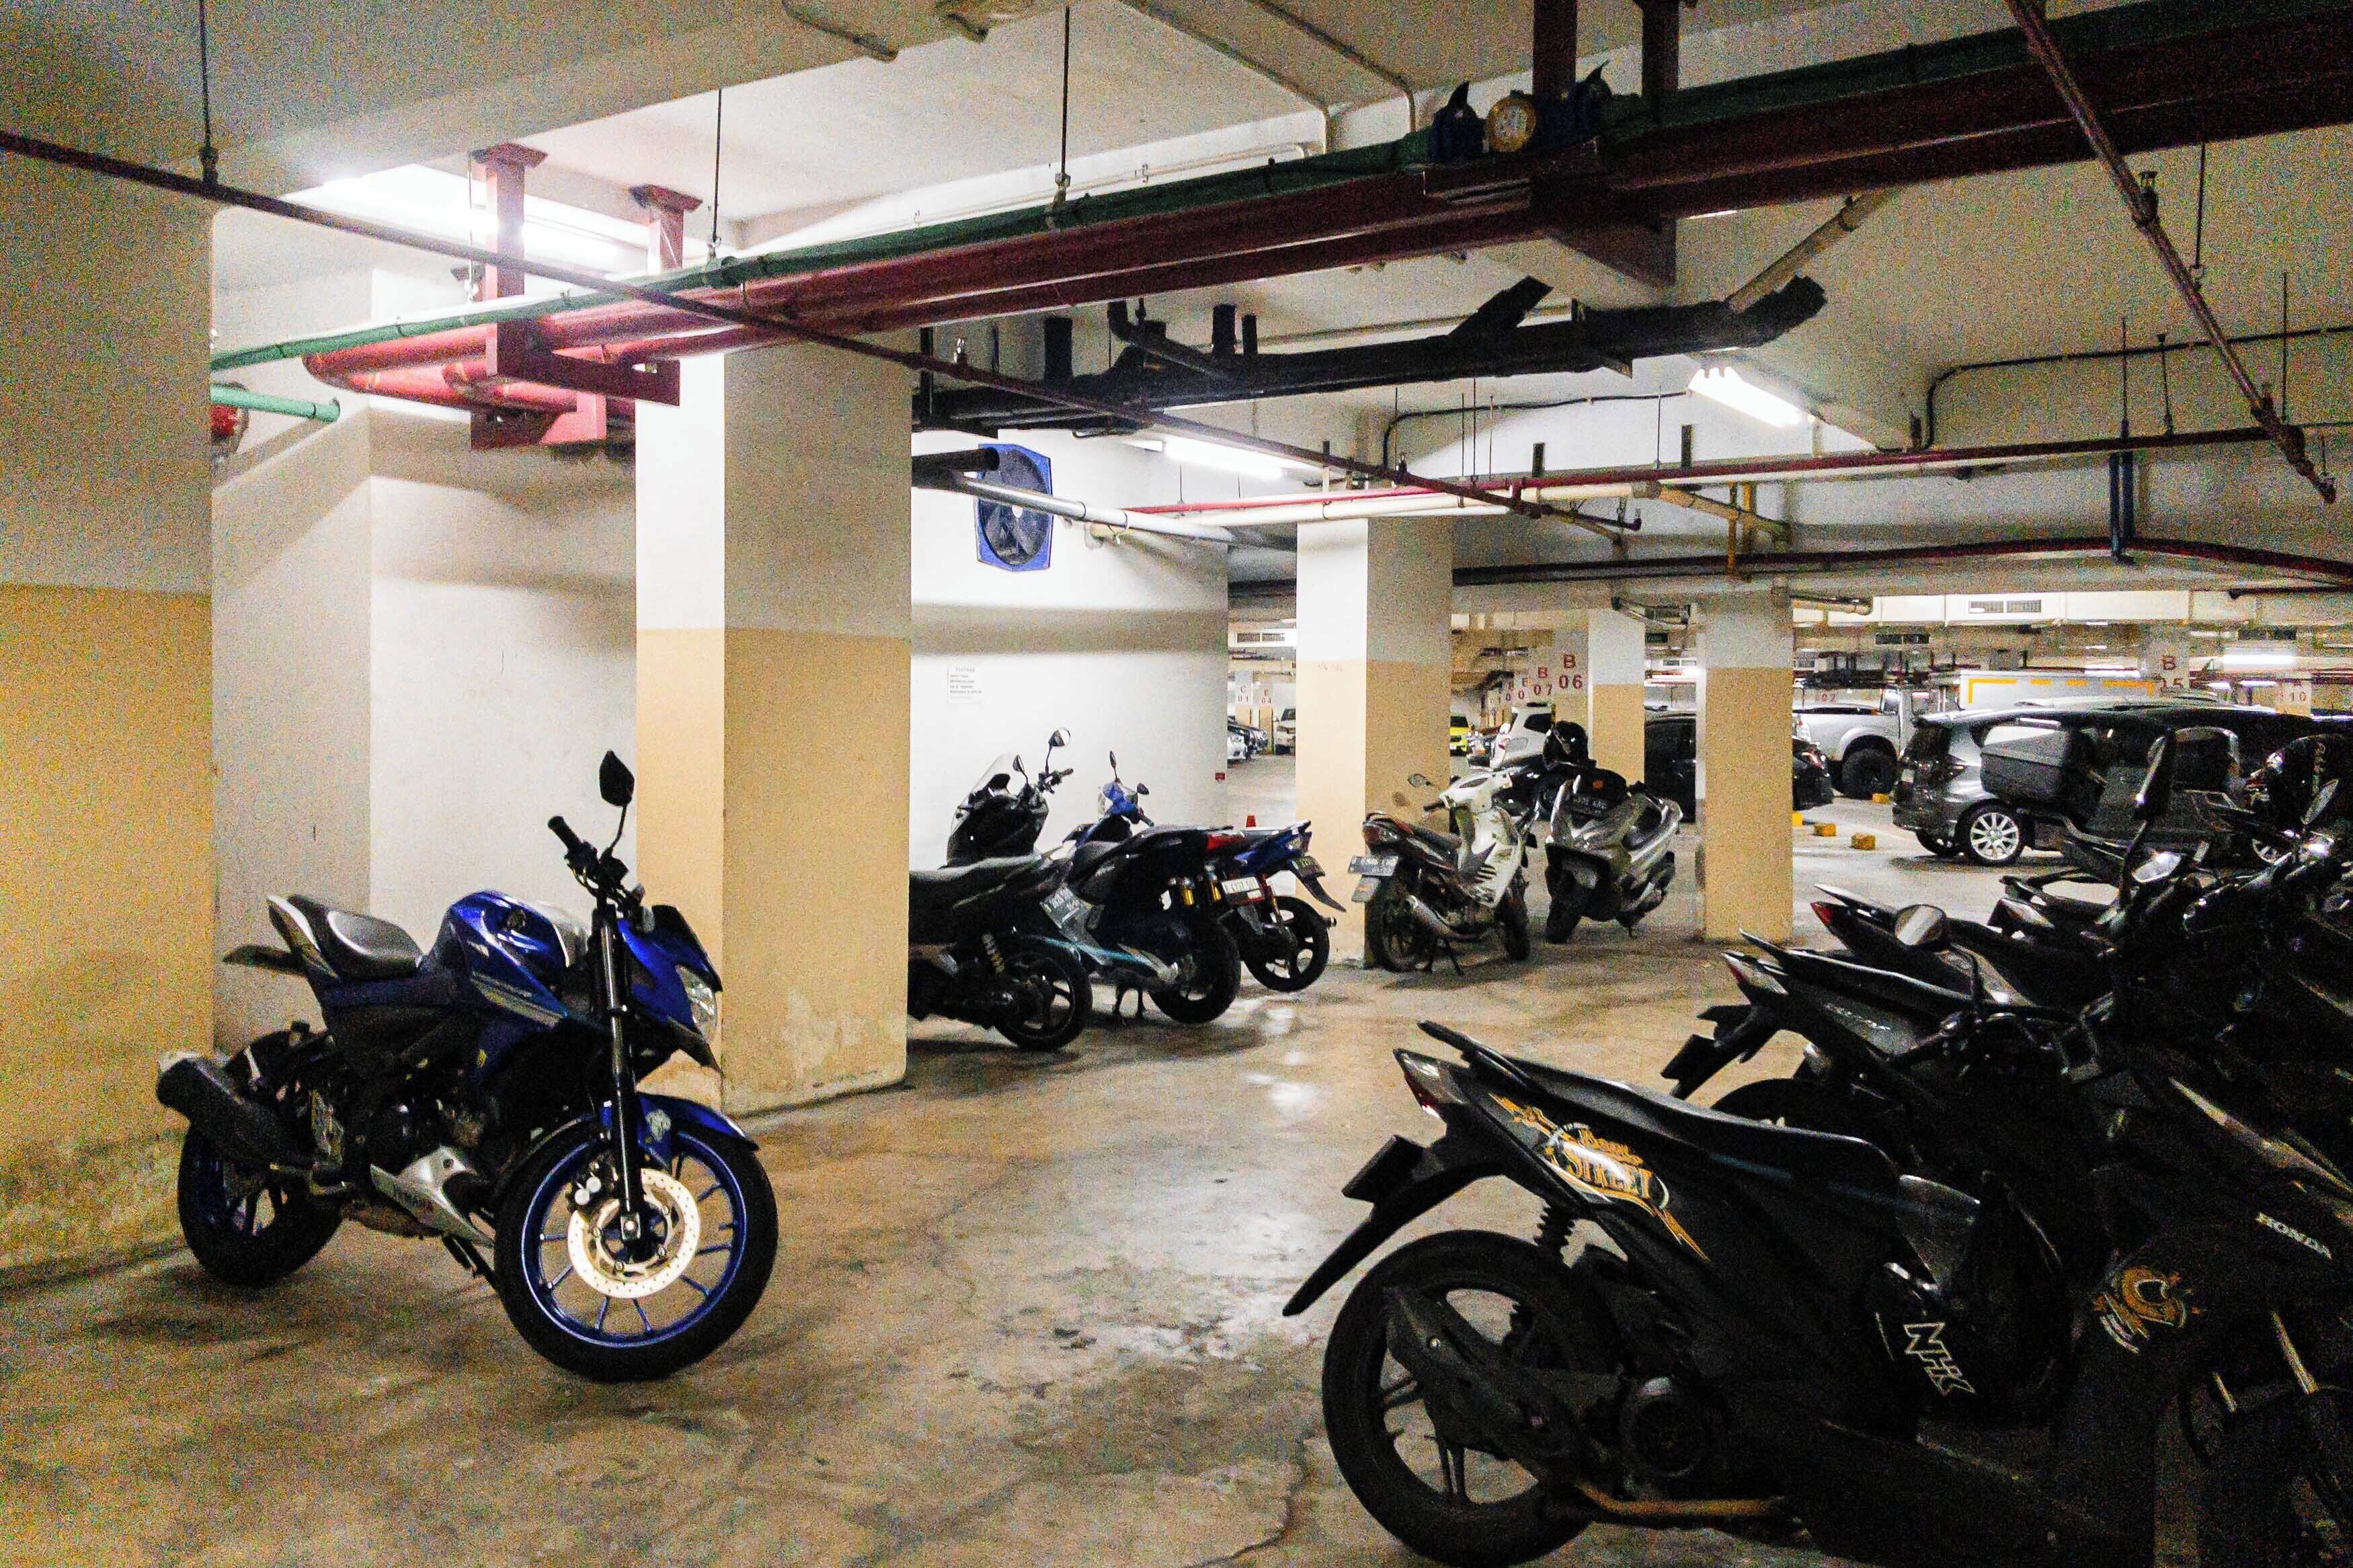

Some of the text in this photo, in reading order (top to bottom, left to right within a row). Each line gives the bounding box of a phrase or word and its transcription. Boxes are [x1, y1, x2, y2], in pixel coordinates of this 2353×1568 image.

[1563, 654, 1576, 669] B
[2163, 655, 2177, 670] B
[1538, 666, 1548, 678] B
[1558, 674, 1583, 689] 06
[1533, 684, 1552, 696] 07
[2255, 1212, 2332, 1259] HONDA
